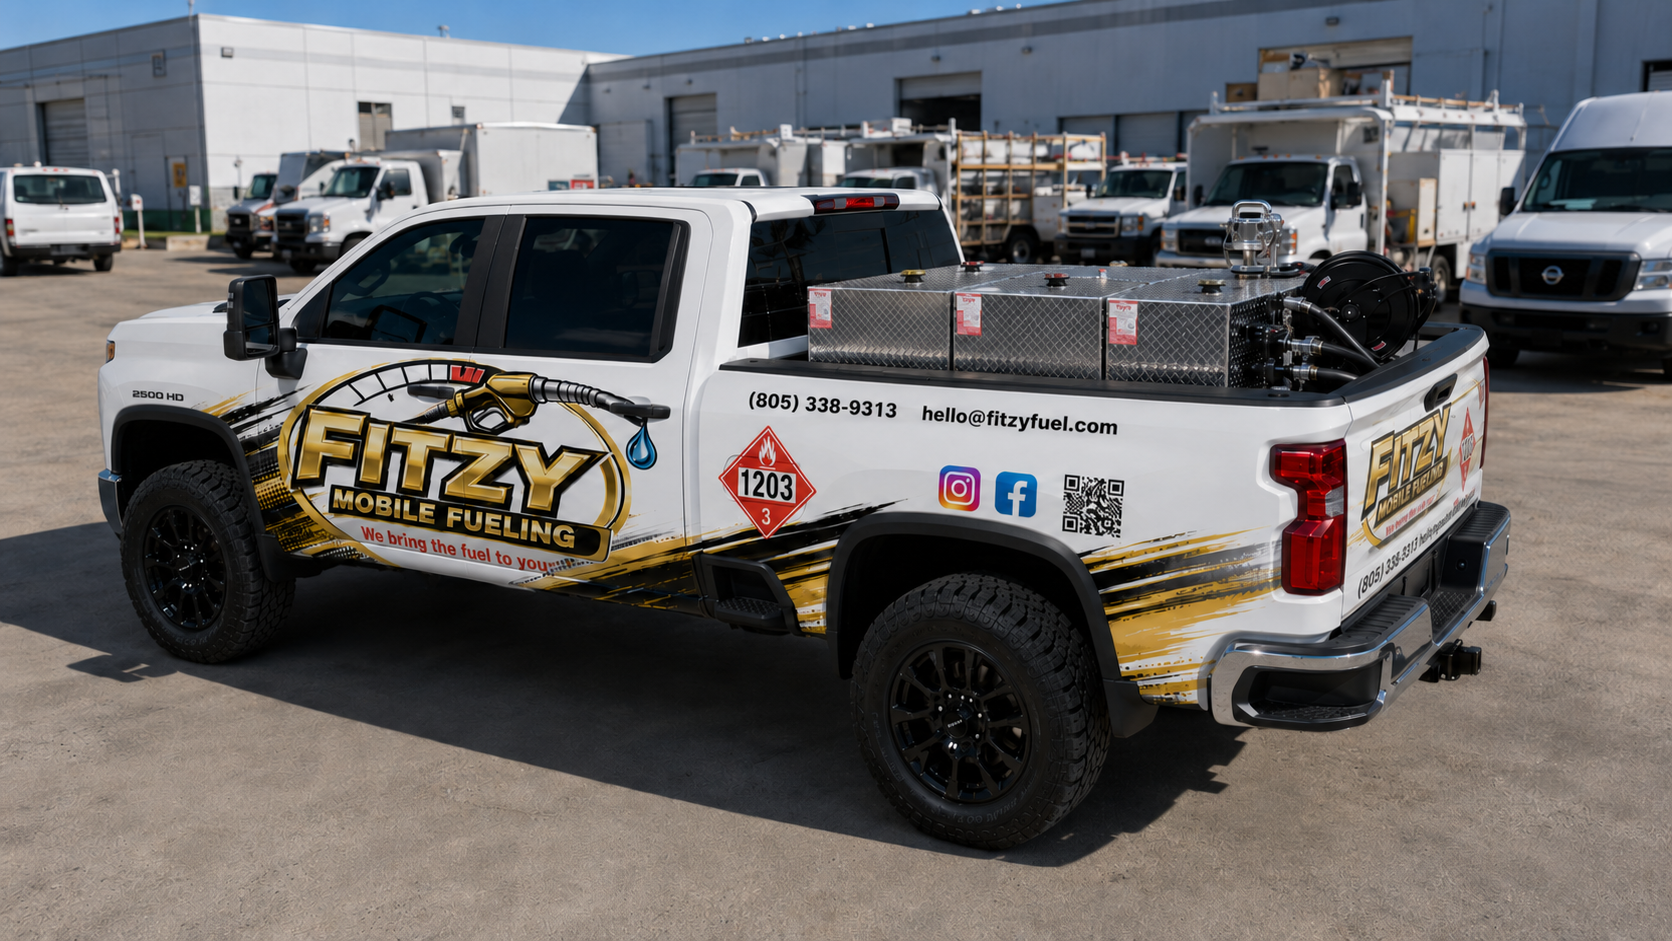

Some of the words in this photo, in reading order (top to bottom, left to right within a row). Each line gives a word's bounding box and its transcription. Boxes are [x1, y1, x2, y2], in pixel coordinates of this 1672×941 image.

[132, 389, 164, 400] 2500
[166, 392, 184, 402] HD
[748, 391, 800, 413] (805)
[804, 396, 898, 419] 338-9313
[921, 405, 1119, 436] hello@fitzyfuel.com
[294, 406, 597, 514] FITZY
[1363, 403, 1451, 515] FITZY
[740, 468, 794, 502] 1203
[1377, 483, 1411, 522] MOBILE
[332, 487, 437, 525] MOBILE
[446, 507, 576, 550] FUELING
[761, 507, 771, 526] 3
[360, 525, 384, 542] We
[387, 529, 427, 553] bring
[430, 538, 457, 556] the
[460, 543, 491, 562] fuel
[495, 550, 513, 566] to
[1357, 562, 1385, 600] (805)
